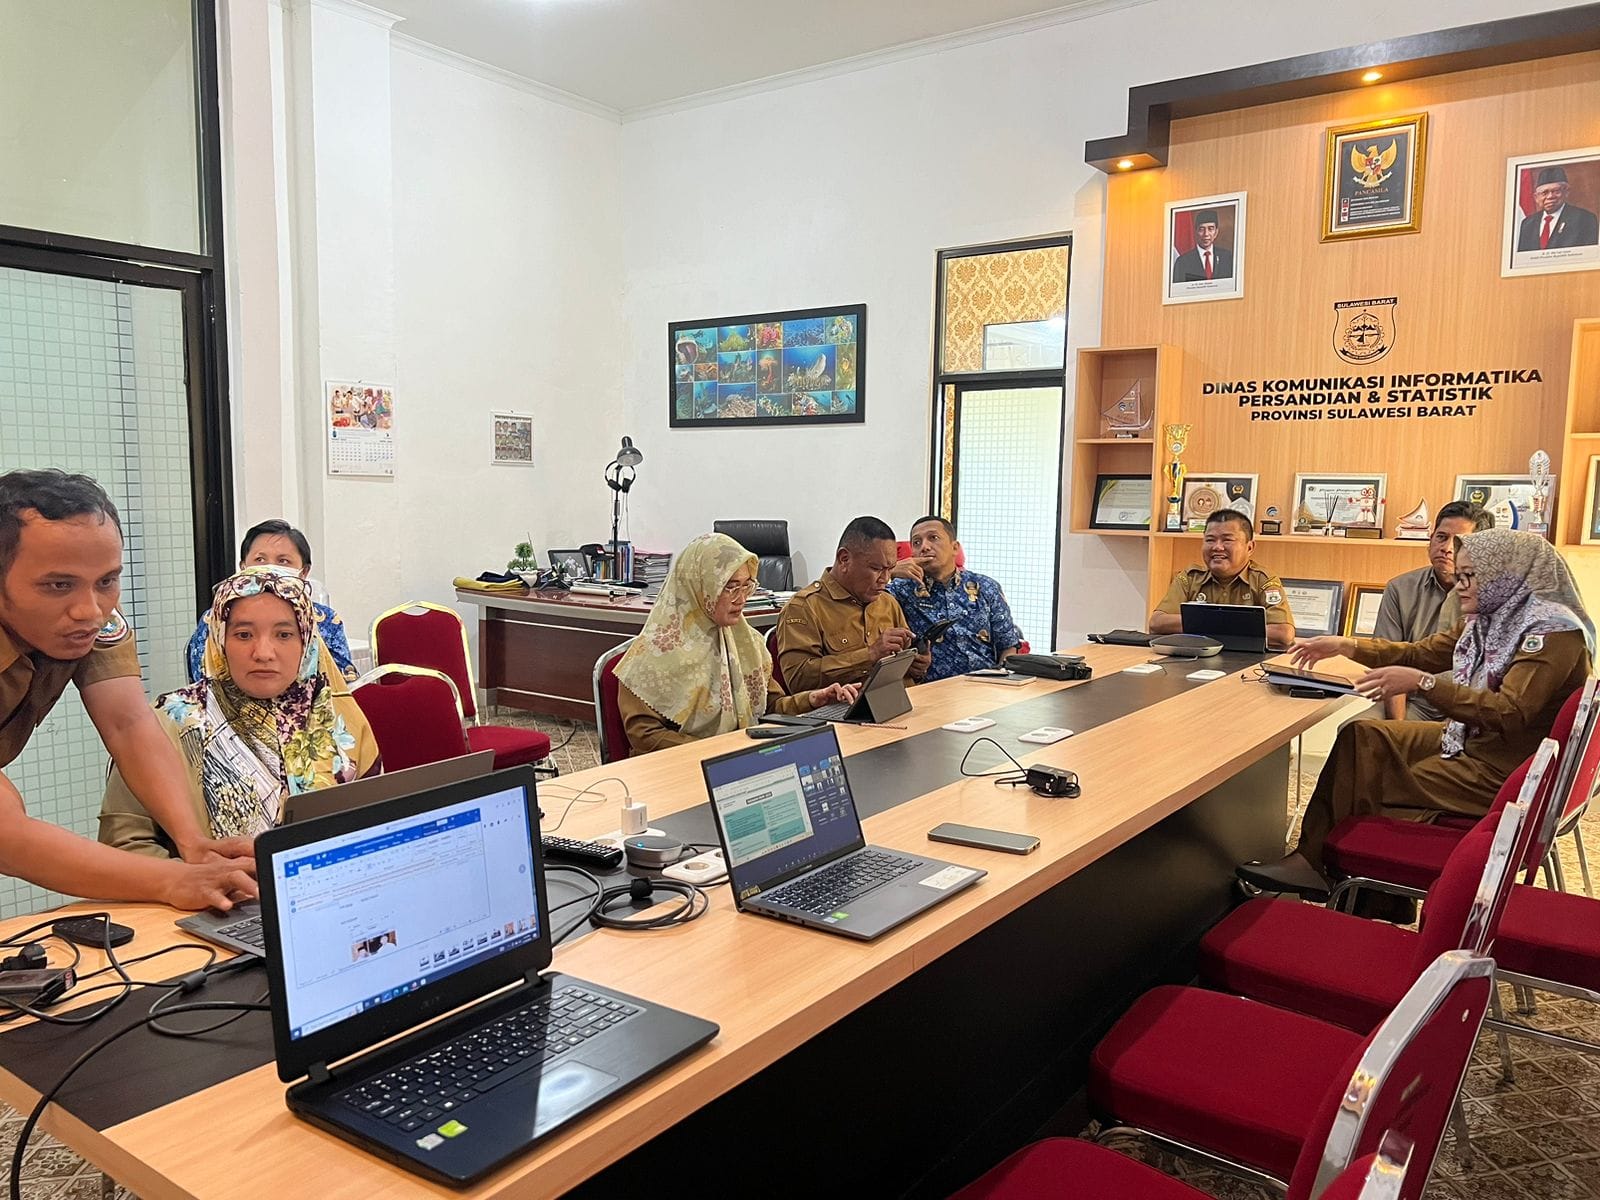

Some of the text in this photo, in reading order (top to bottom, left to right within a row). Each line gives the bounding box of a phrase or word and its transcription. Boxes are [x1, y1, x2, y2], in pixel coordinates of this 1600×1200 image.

[1355, 188, 1389, 196] PANCASILA
[1203, 369, 1542, 394] DINAS KOMUNIKASI INFORMATIKA
[1239, 387, 1493, 407] PERSANDIAN & STATISTIK
[1251, 405, 1476, 421] PROVINSI SULAWESI BARAT
